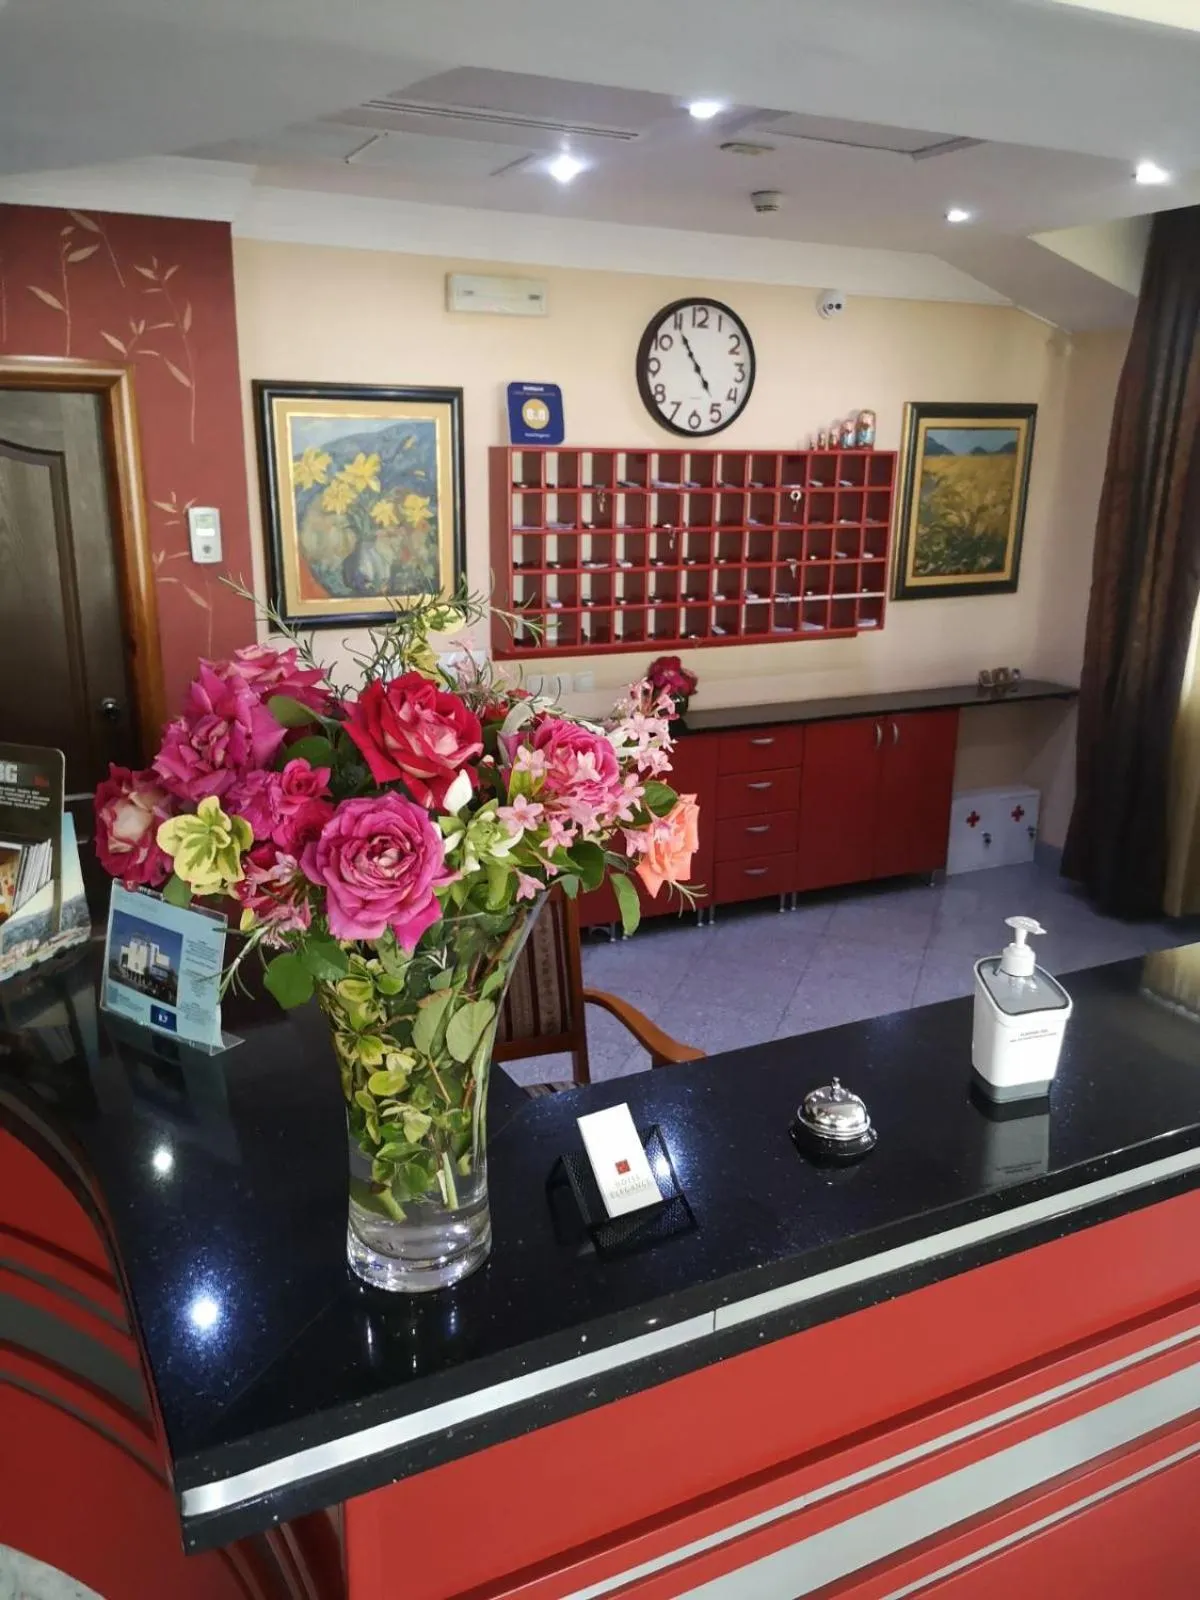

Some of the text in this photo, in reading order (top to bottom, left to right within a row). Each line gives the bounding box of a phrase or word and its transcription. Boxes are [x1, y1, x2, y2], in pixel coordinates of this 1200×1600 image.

[674, 311, 684, 331] 11
[692, 306, 709, 329] 12
[718, 314, 723, 333] 1
[654, 333, 673, 351] 10
[728, 333, 741, 356] 2
[648, 357, 661, 378] 9
[733, 362, 746, 383] 3
[653, 383, 666, 404] 8
[726, 387, 738, 404] 4
[670, 401, 682, 421] 7
[688, 409, 702, 430] 6
[709, 403, 722, 424] 5
